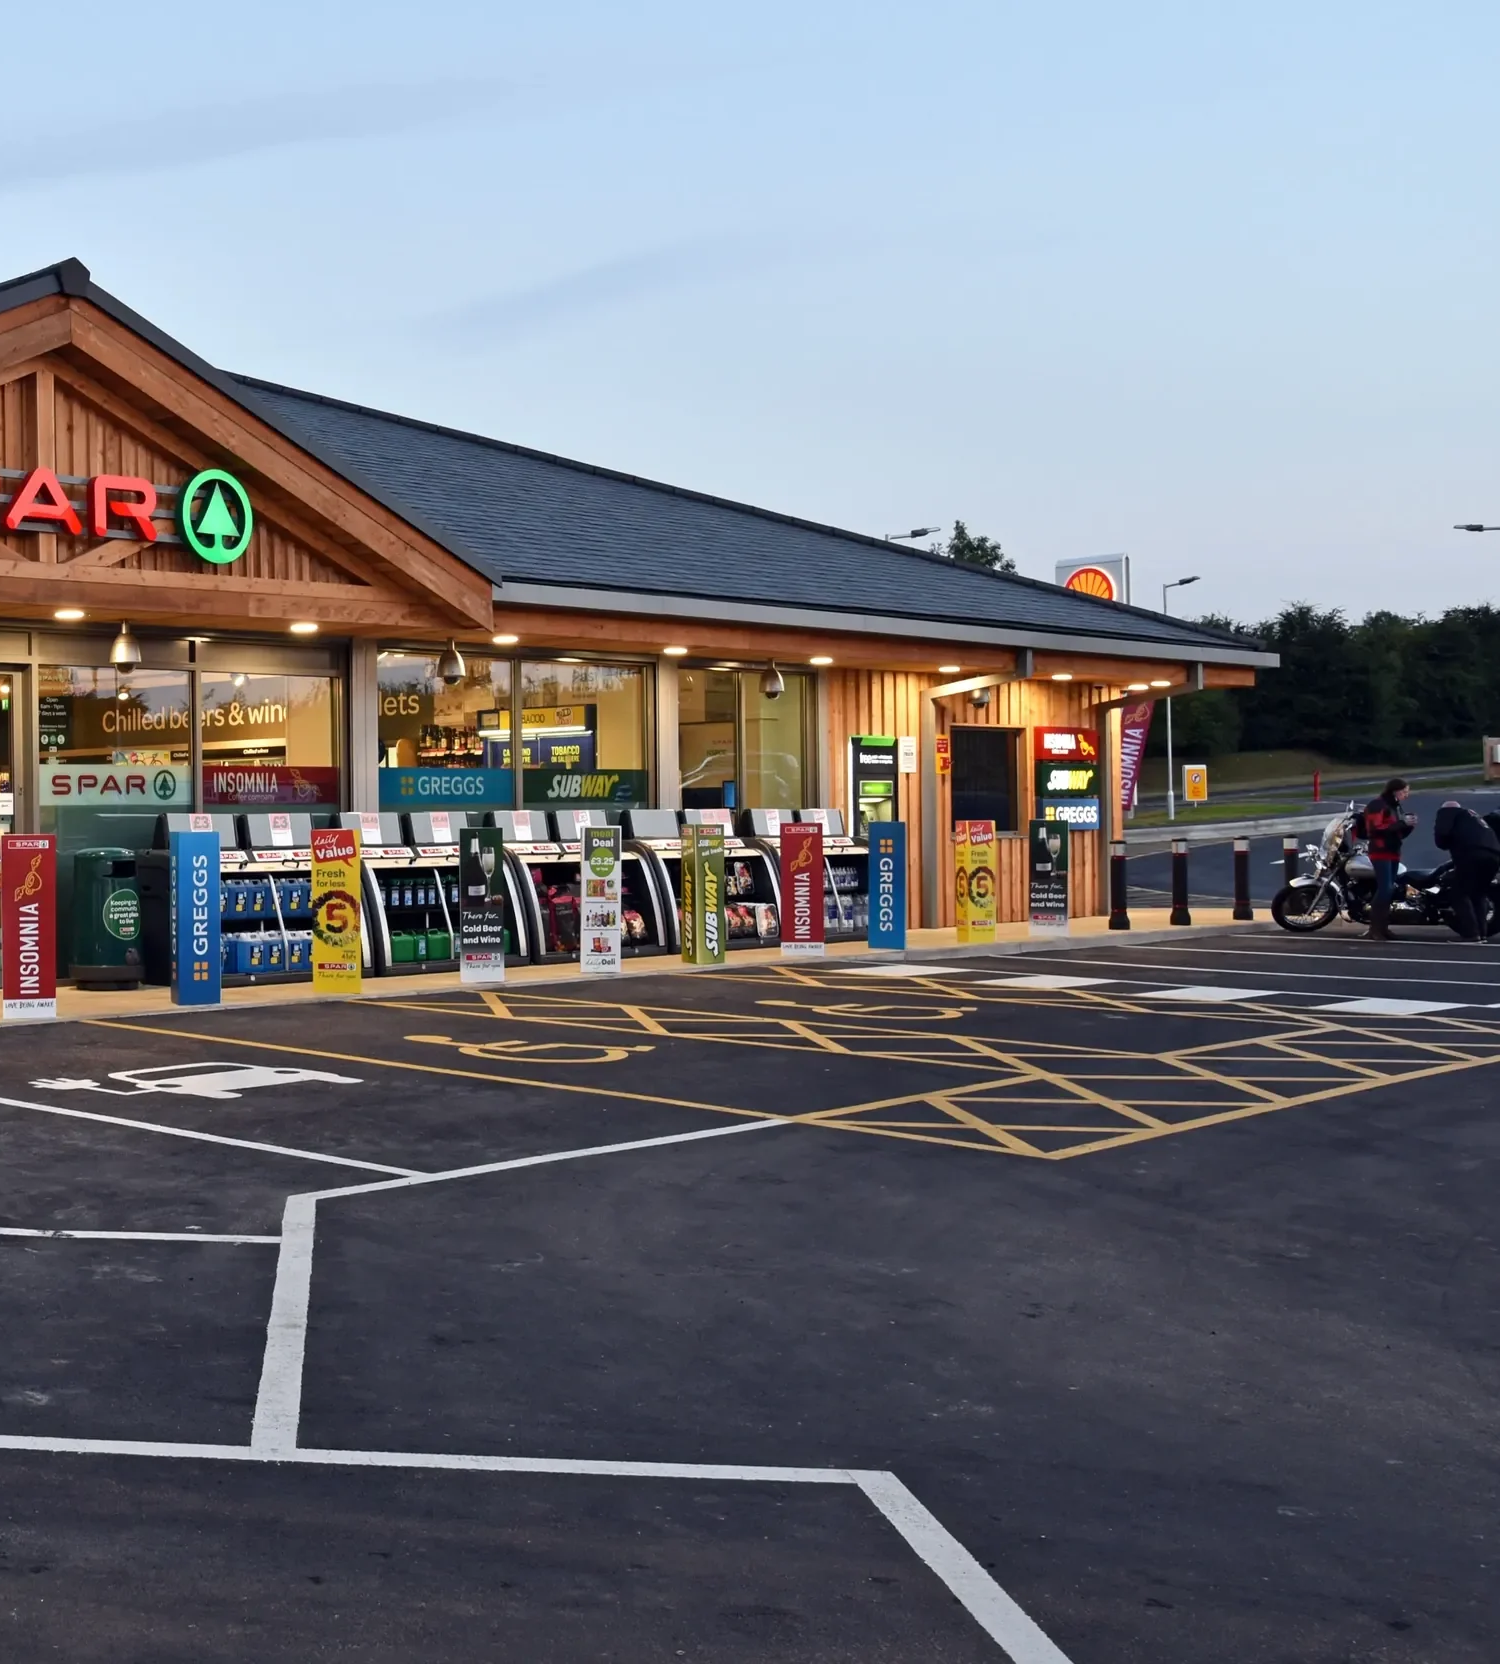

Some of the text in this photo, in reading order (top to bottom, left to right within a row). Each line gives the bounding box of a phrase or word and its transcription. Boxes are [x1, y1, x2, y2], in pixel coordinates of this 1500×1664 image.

[379, 692, 420, 717] lets
[102, 706, 166, 733] Chilled
[228, 701, 245, 726] &
[551, 745, 580, 756] TOBACCO
[51, 774, 146, 796] SPAR
[213, 771, 279, 794] INSOMNIA
[417, 775, 485, 796] GREGGS
[547, 773, 620, 799] SUBWAY
[1047, 769, 1094, 790] SUBWAY
[193, 816, 209, 829] £3
[273, 816, 288, 829] £3
[1056, 806, 1097, 823] GREGGS
[314, 834, 339, 849] daily
[591, 830, 614, 838] meal
[971, 832, 993, 843] Value
[592, 838, 614, 848] Deal
[316, 844, 354, 860] Value
[590, 857, 615, 866] £3.25
[316, 869, 346, 878] Fresh
[316, 880, 346, 888] for less
[879, 858, 893, 931] GREGGS
[193, 854, 208, 956] GREGGS
[684, 861, 693, 957] SUBWAY
[704, 861, 719, 958] SUBWAY
[794, 872, 811, 939] INSOMNIA
[463, 911, 482, 920] There
[463, 925, 482, 933] Cold
[463, 936, 501, 944] and Wine
[19, 902, 40, 995] INSOMNIA
[601, 958, 616, 966] Deli
